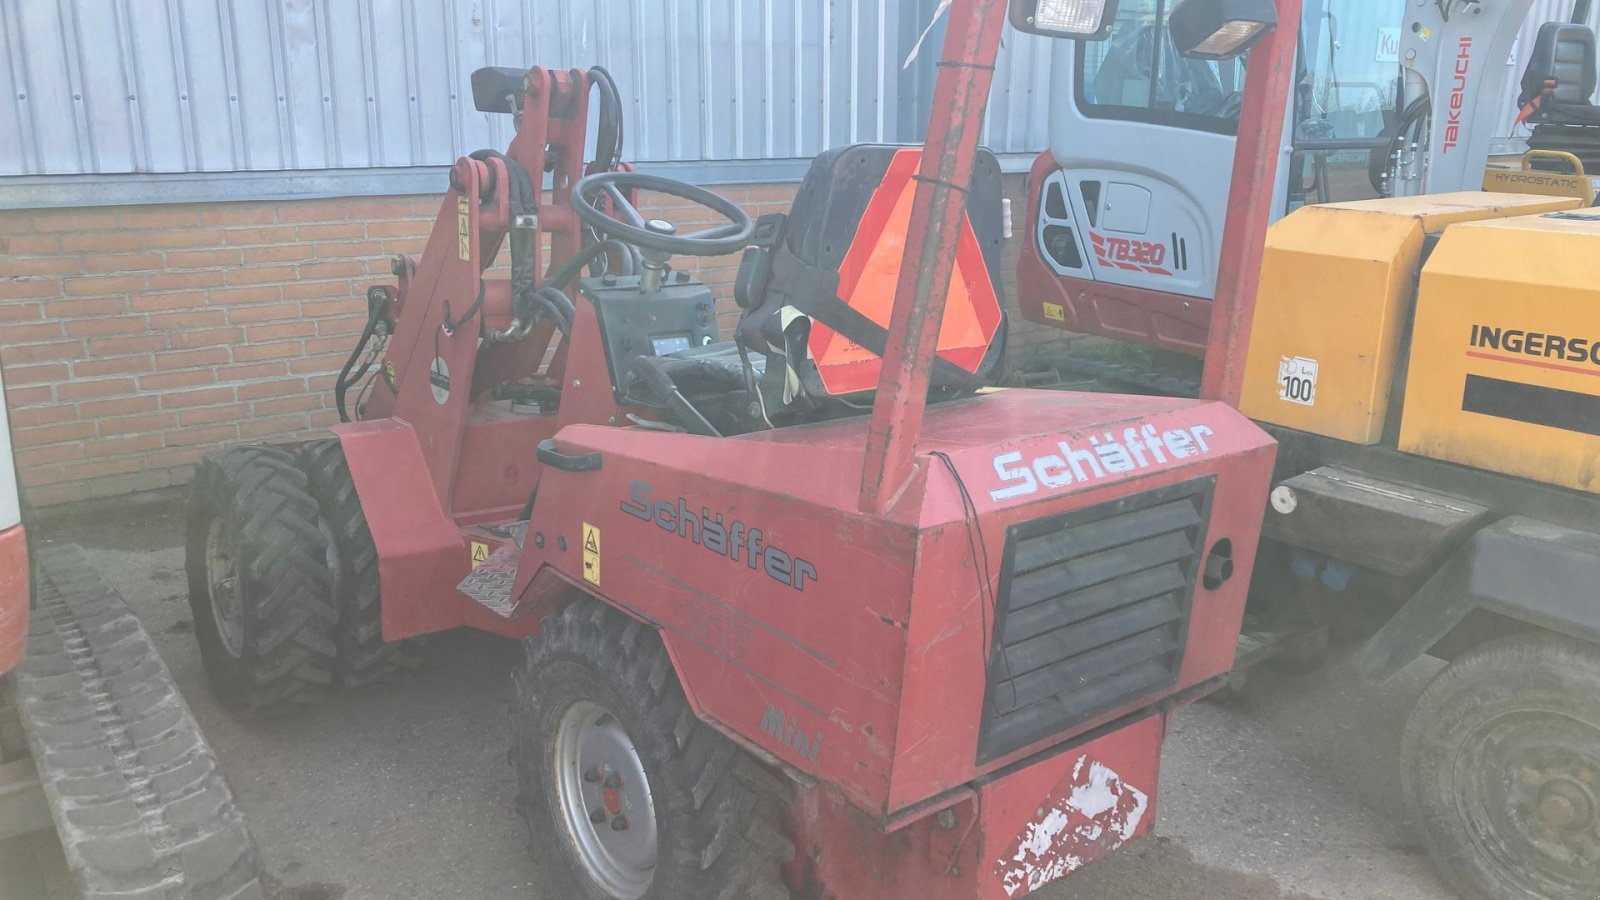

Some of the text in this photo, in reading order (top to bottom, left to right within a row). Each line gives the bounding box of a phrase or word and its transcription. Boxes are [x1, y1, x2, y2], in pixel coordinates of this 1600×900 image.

[1443, 36, 1472, 154] TAKEUCHI
[1495, 173, 1578, 189] HYDROSTATIC
[1106, 237, 1166, 266] TB320
[1283, 375, 1313, 402] 100
[989, 423, 1214, 502] Schäffer
[620, 479, 818, 592] Schäffer
[760, 703, 825, 763] Mini
